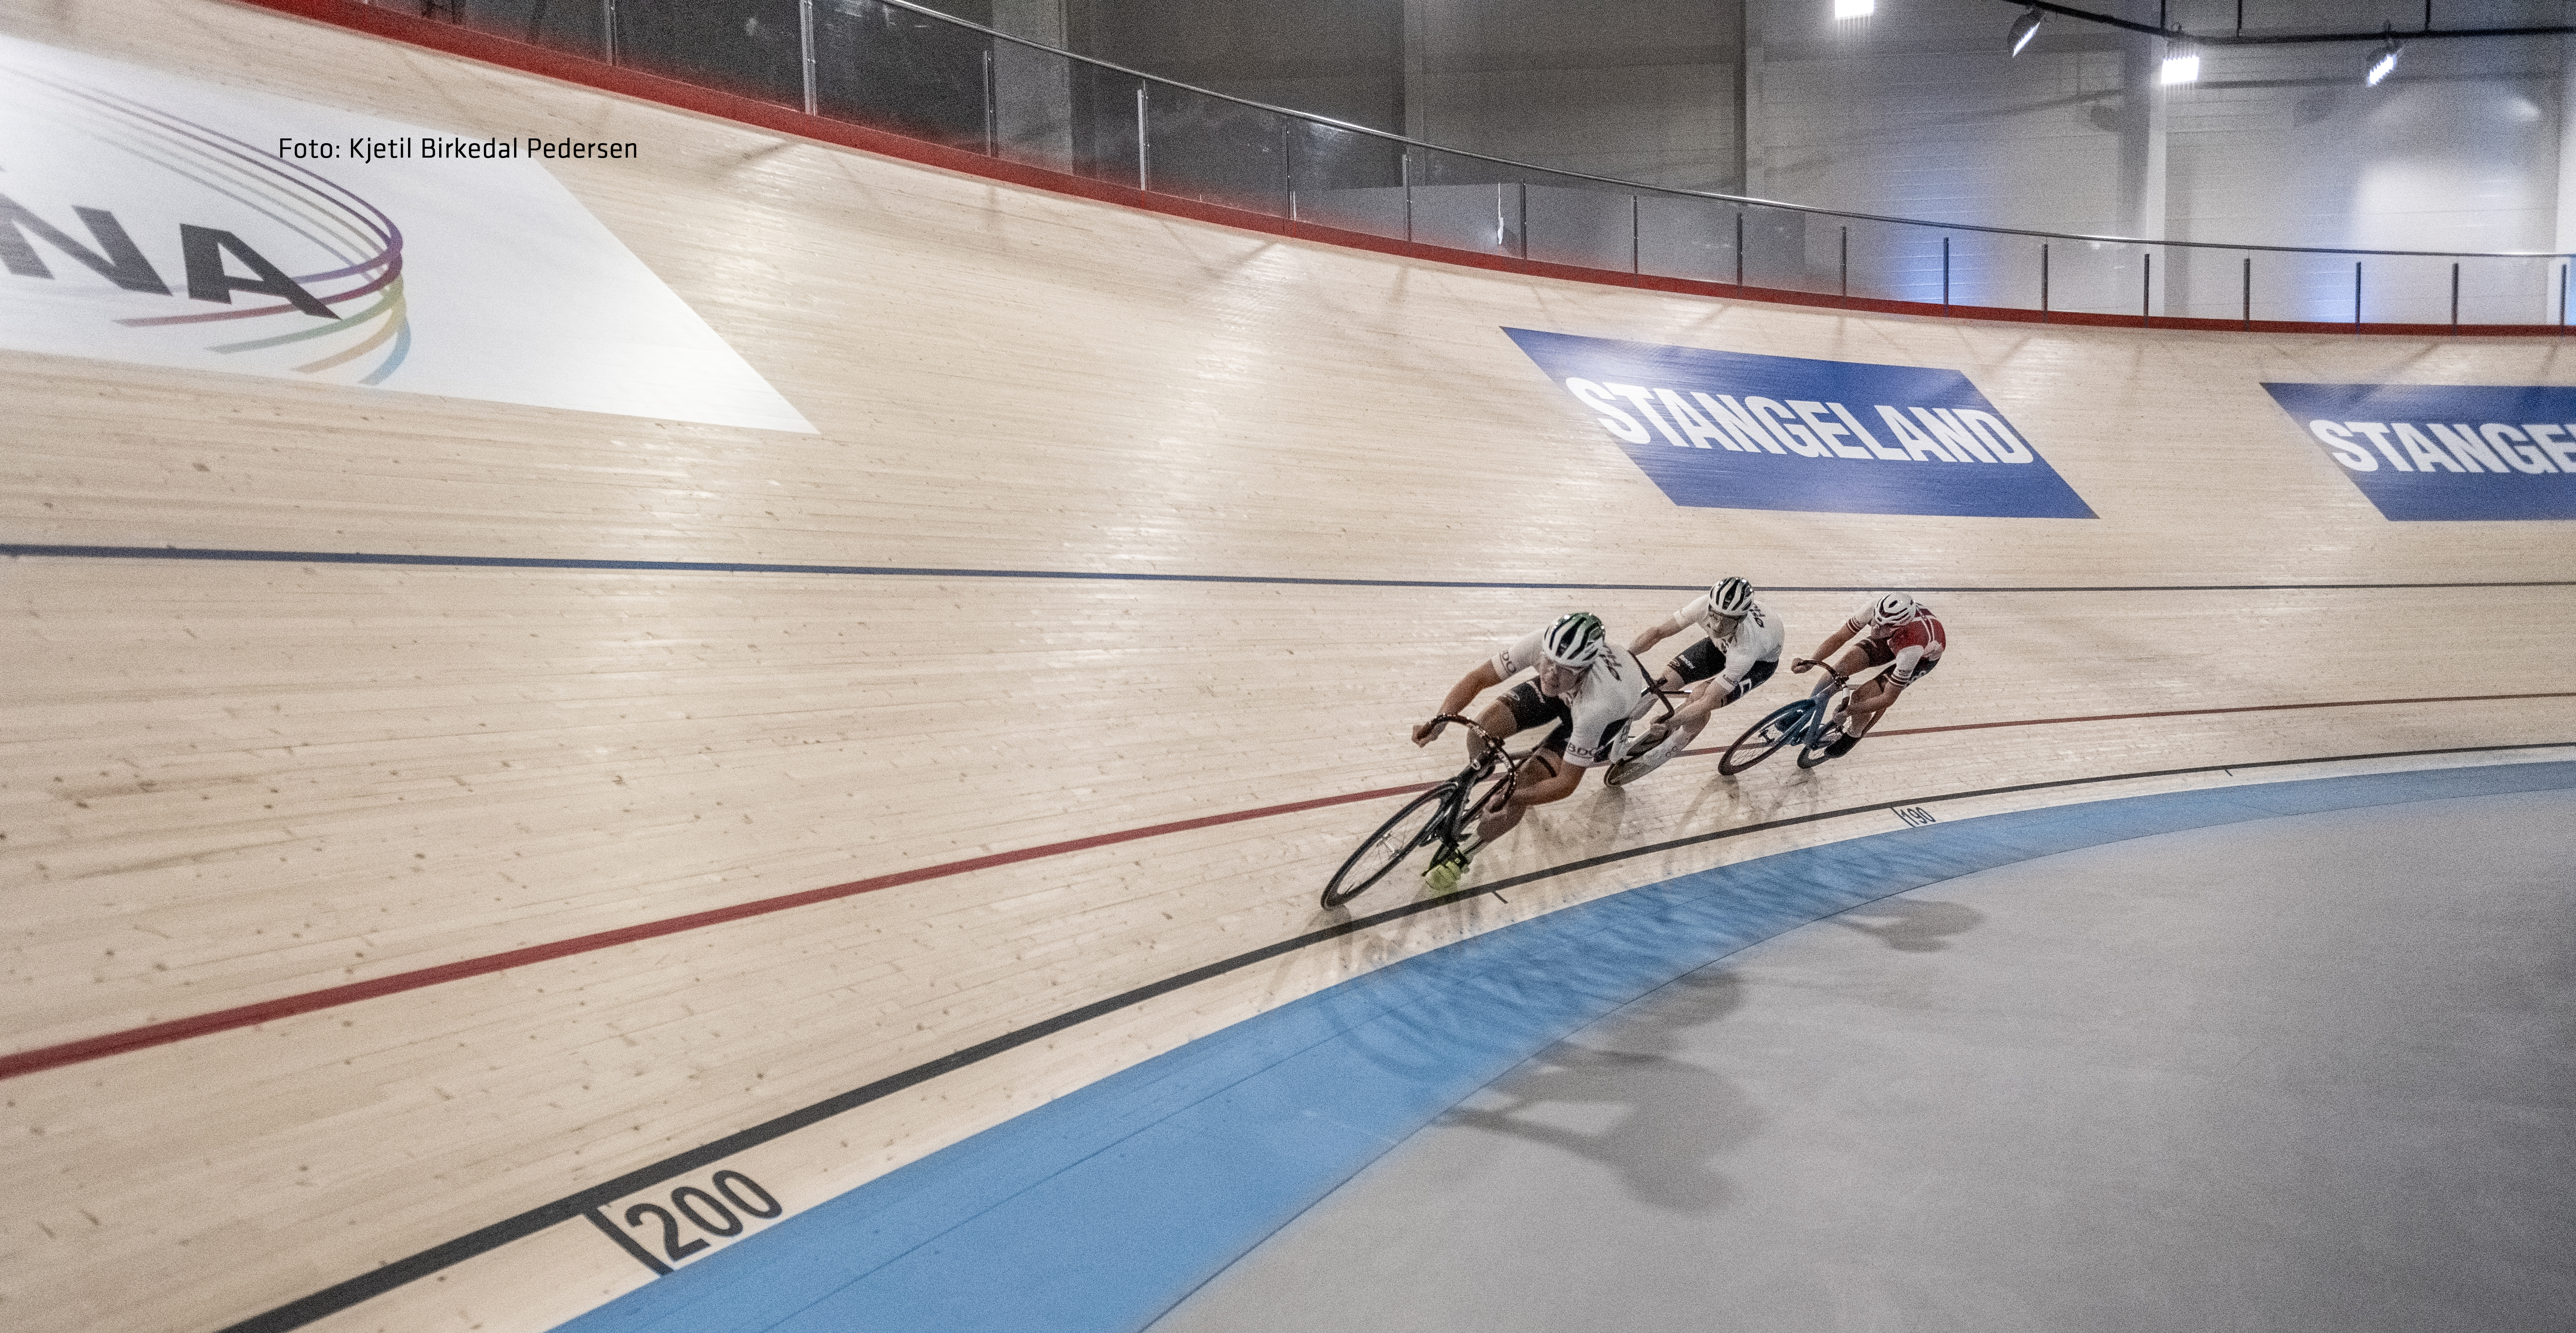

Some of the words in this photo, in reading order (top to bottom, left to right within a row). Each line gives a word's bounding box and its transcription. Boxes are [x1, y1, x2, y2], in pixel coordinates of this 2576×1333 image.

[1565, 377, 2034, 464] STANGELAND
[2309, 420, 2576, 474] STANGE
[1899, 806, 1936, 825] 190
[624, 1169, 783, 1262] 200
